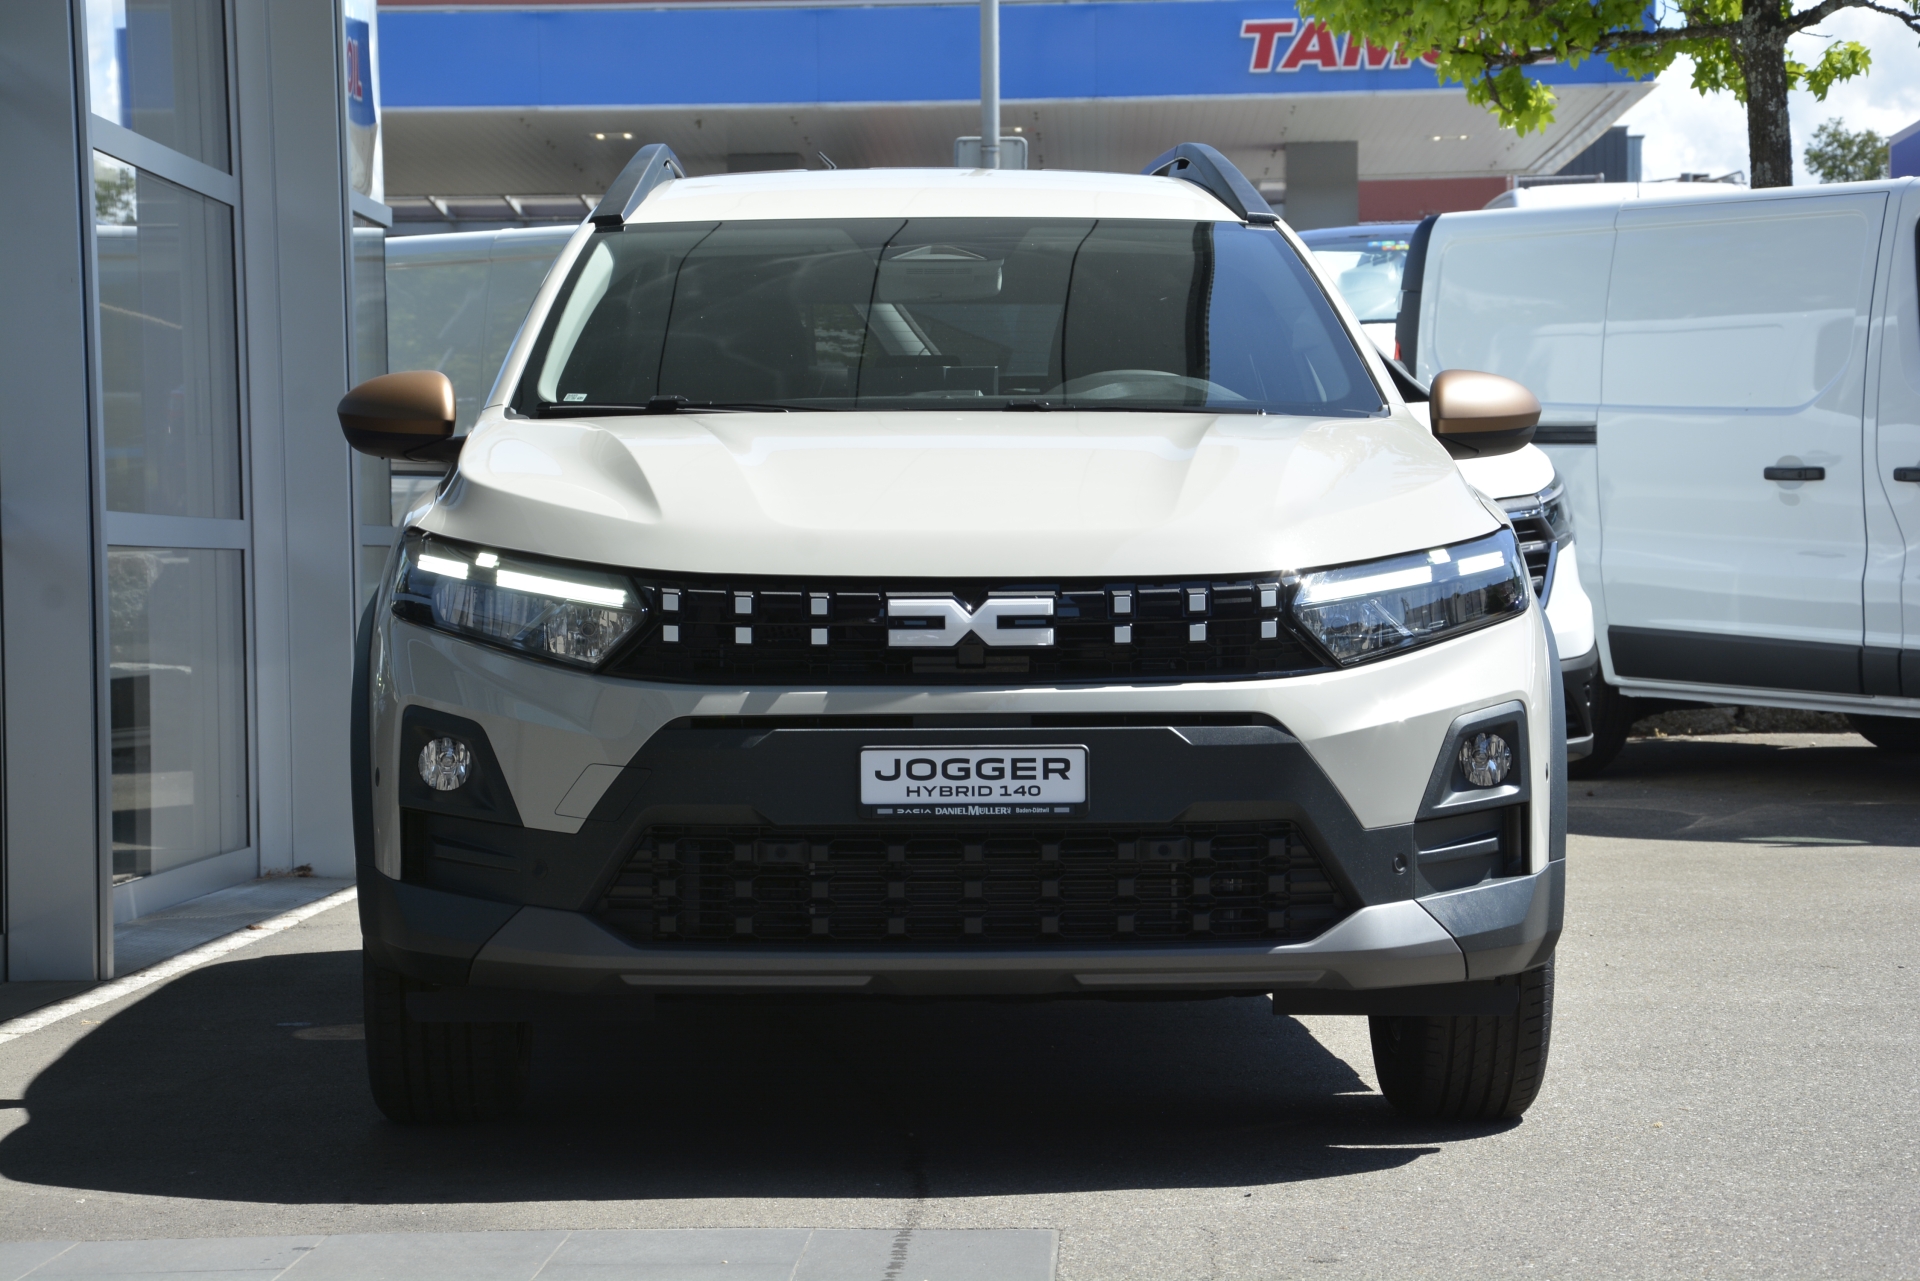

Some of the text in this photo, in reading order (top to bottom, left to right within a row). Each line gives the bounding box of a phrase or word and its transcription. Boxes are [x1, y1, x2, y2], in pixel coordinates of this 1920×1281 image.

[1240, 18, 1557, 73] TAM
[874, 757, 1071, 782] JOGGER
[906, 785, 1042, 798] HYBRID 140
